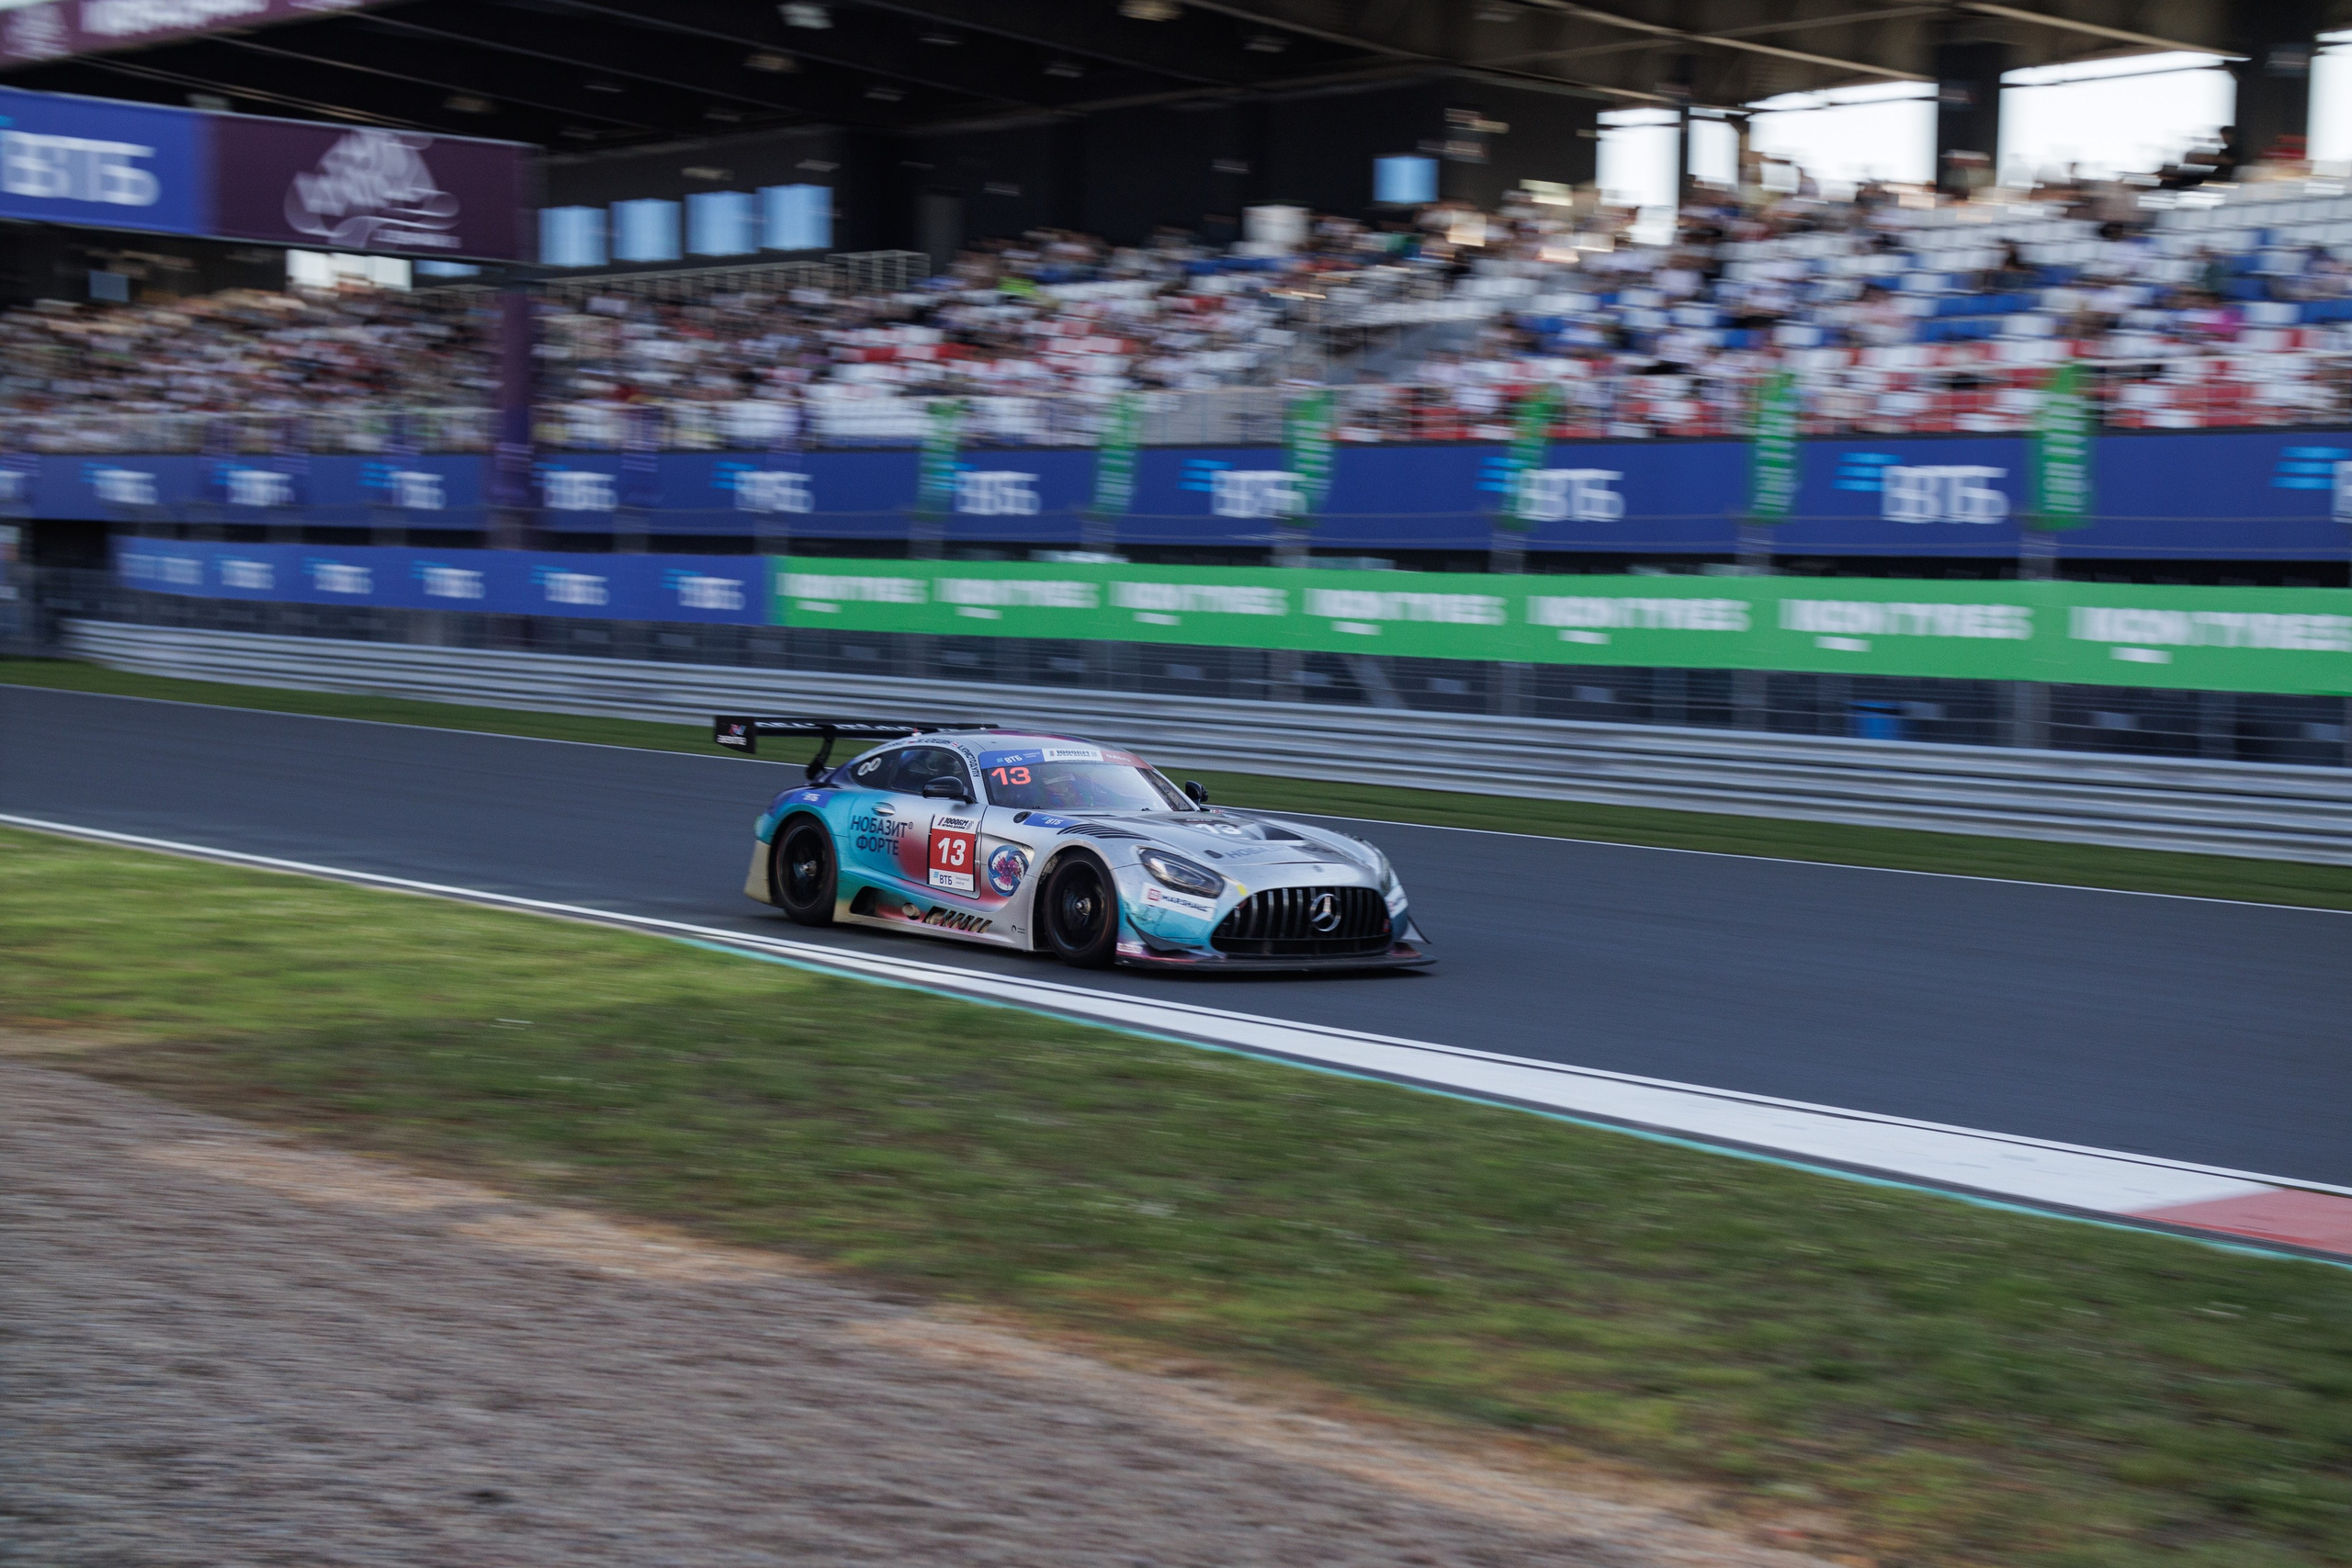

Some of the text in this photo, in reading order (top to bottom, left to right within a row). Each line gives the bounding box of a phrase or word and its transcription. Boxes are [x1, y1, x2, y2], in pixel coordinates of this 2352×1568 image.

[1004, 753, 1023, 764] ВТБ
[990, 766, 1032, 786] 13
[855, 834, 900, 856] ФОРТЕ
[937, 837, 967, 866] 13
[939, 874, 953, 886] ВТБ
